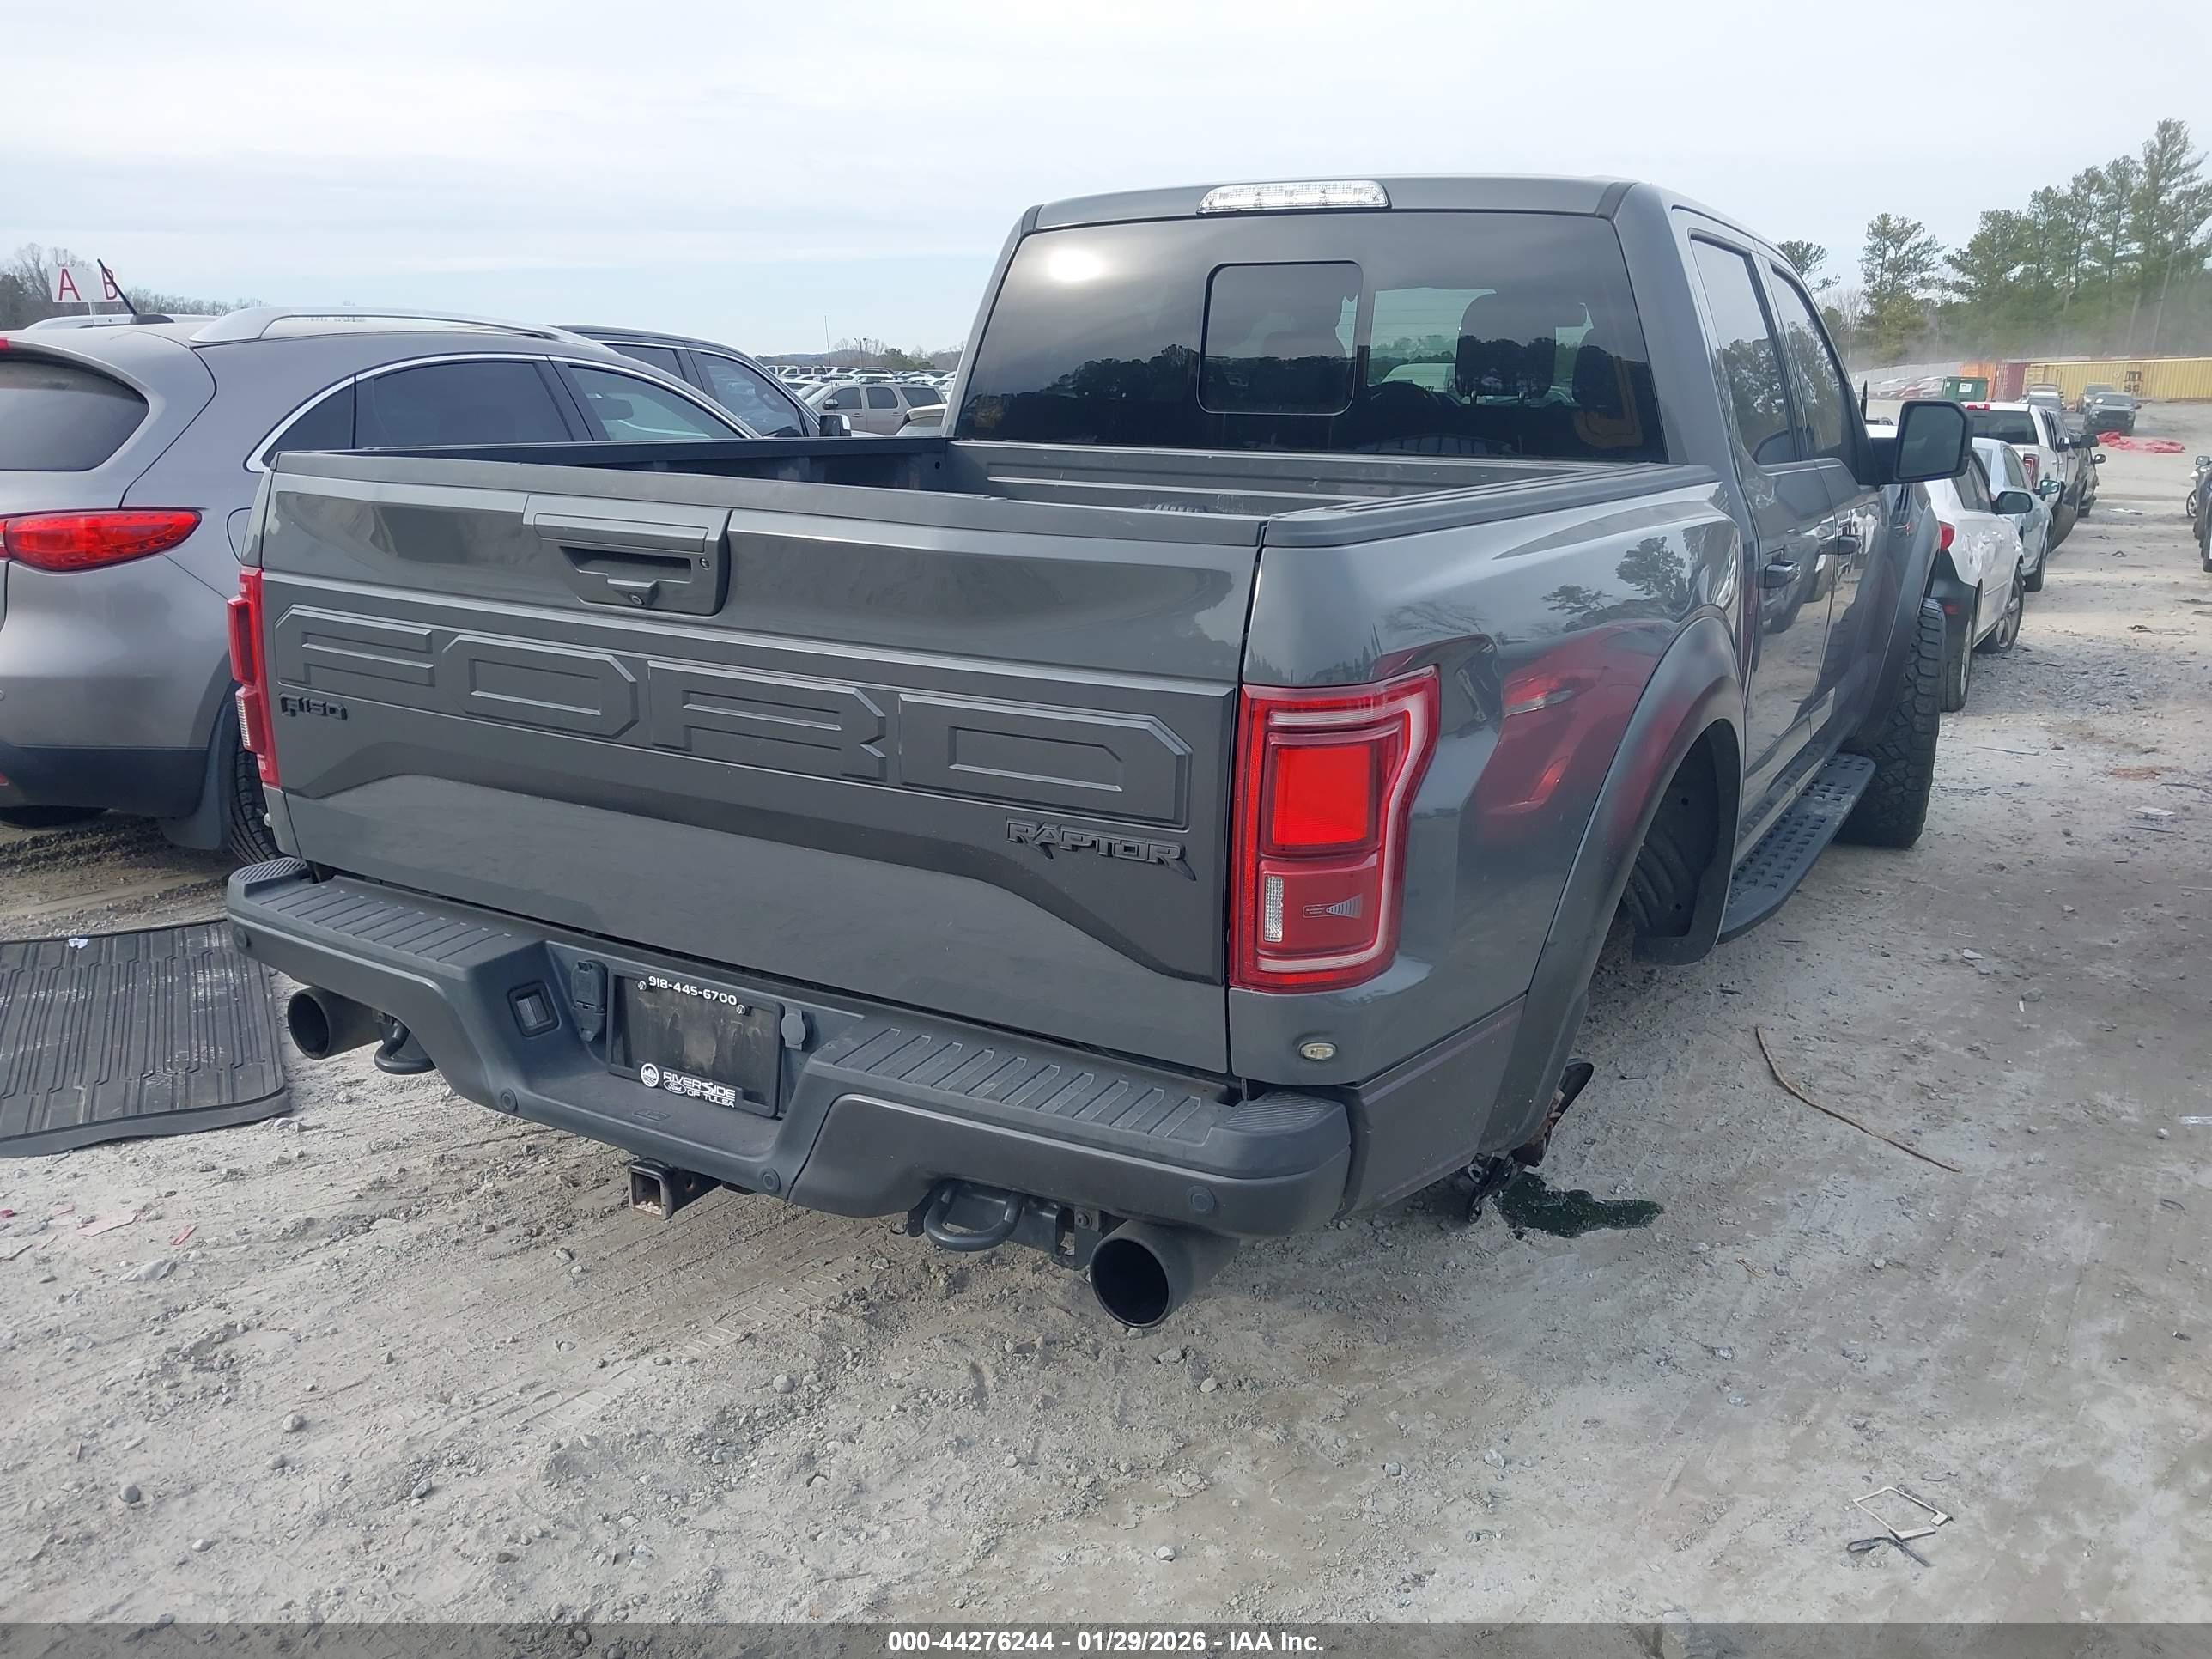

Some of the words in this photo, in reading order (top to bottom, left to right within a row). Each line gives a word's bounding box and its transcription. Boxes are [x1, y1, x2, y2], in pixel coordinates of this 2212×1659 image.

[58, 268, 82, 301] A
[101, 268, 118, 300] B
[274, 604, 1194, 833] FORD
[1006, 817, 1196, 881] RAPTOR
[648, 975, 737, 1005] 918-445-6700
[663, 1071, 736, 1098] RIVERSIDE
[687, 1088, 701, 1097] OF
[703, 1093, 735, 1108] TULSA
